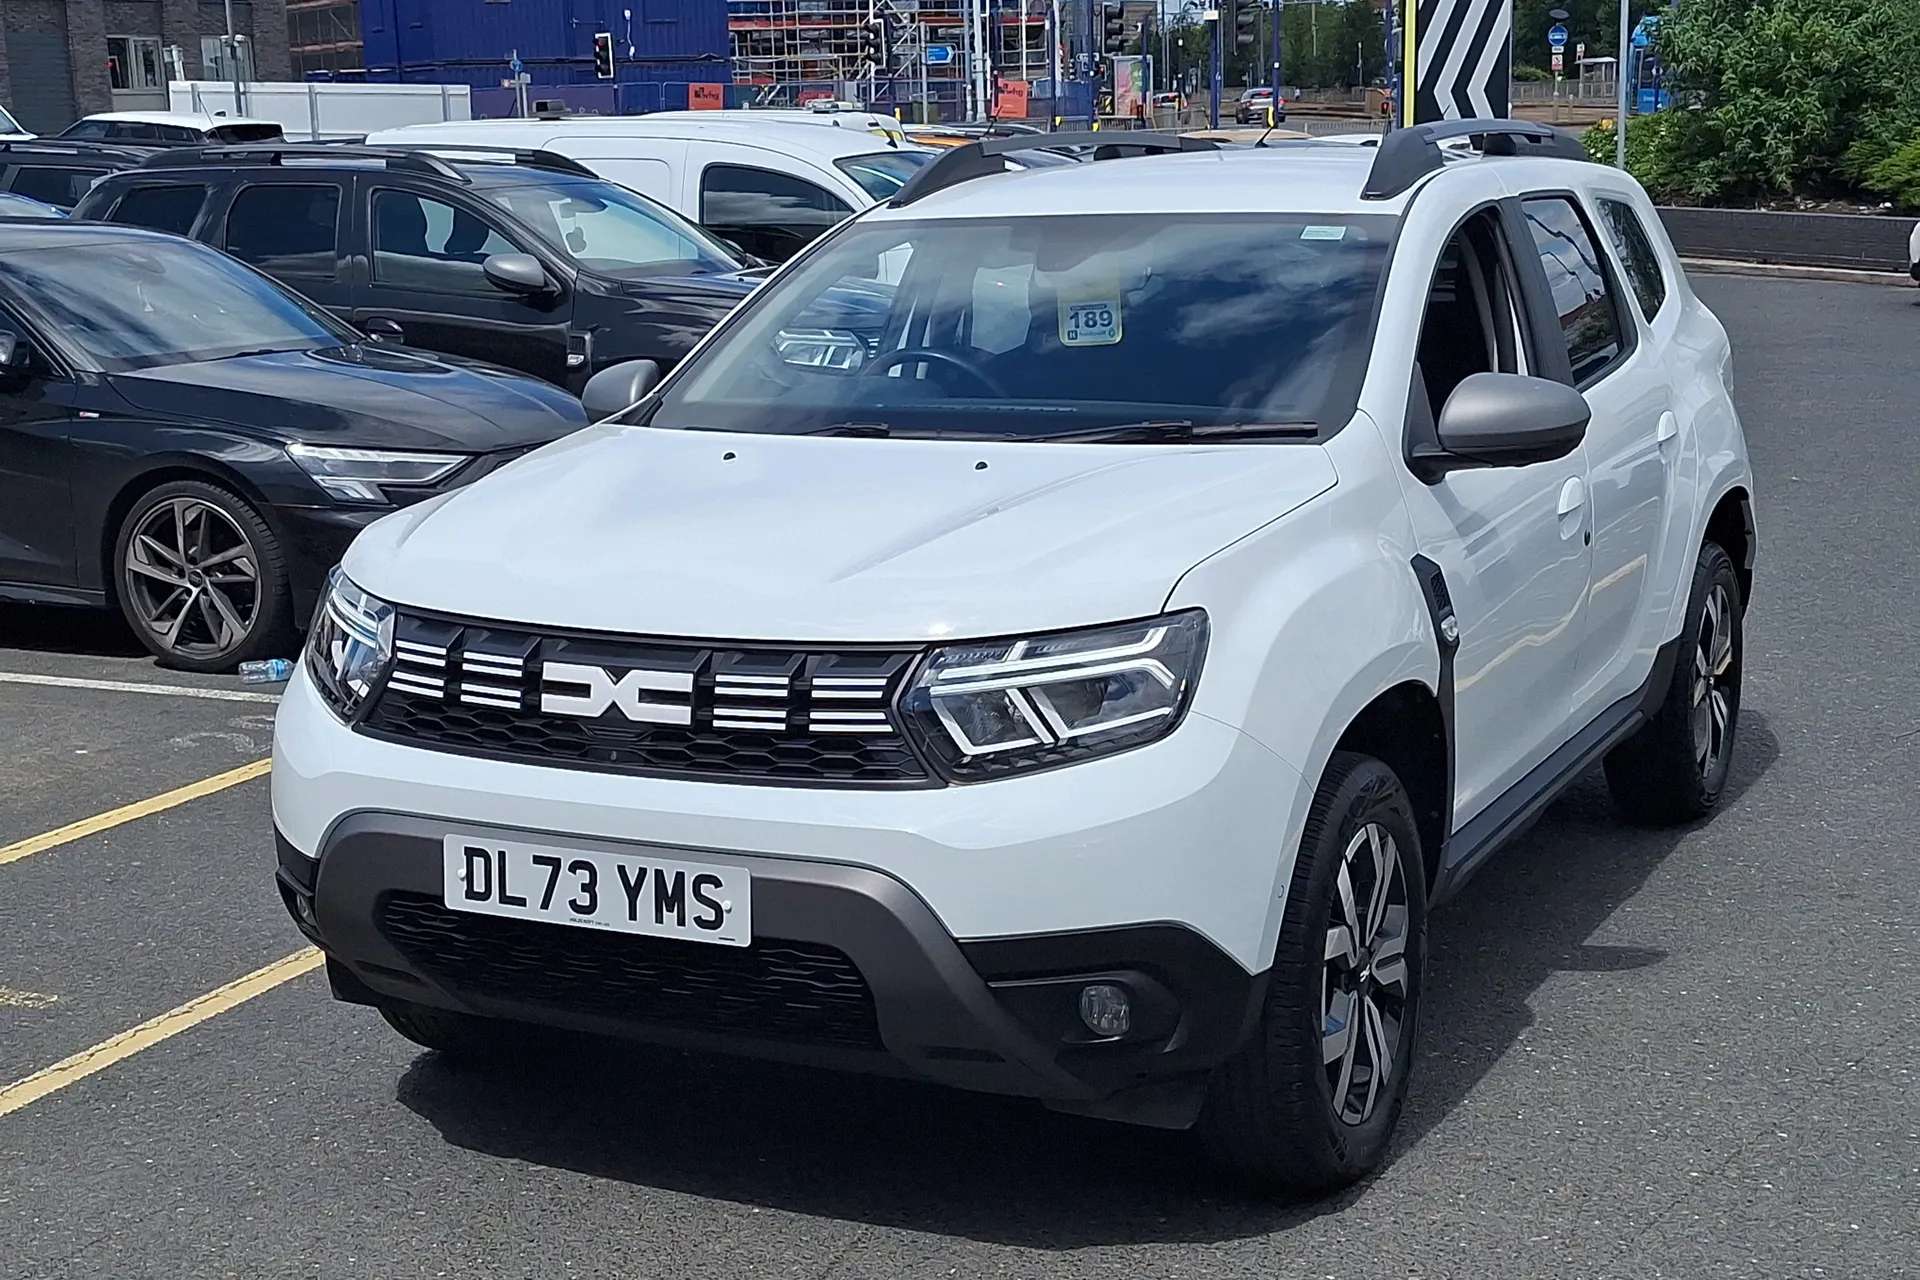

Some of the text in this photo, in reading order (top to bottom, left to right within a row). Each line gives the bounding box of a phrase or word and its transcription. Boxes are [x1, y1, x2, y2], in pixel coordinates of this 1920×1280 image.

[1069, 310, 1113, 329] 189
[464, 846, 724, 931] DL73 YMS
